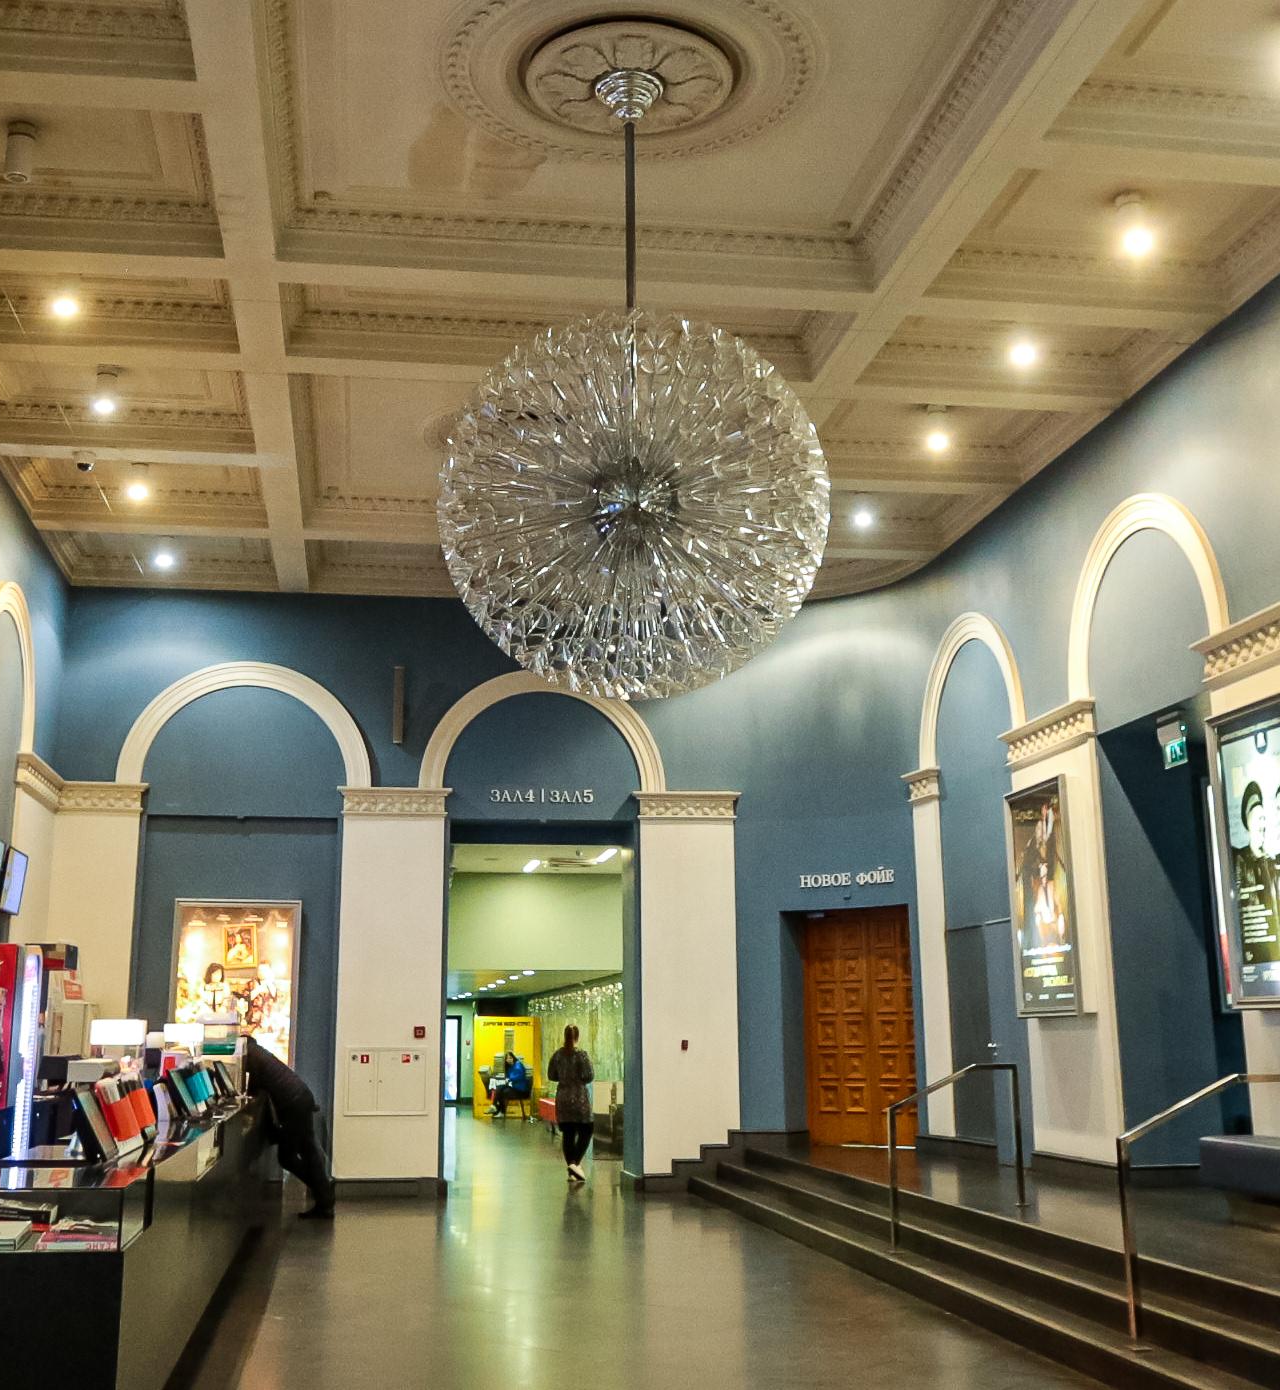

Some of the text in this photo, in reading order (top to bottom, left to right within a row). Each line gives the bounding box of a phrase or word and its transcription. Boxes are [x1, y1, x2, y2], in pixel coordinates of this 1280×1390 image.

[490, 788, 536, 803] ЗАЛ4
[549, 788, 594, 803] ЗАЛ5
[800, 866, 895, 888] НОВОЕ ФОЙЕ
